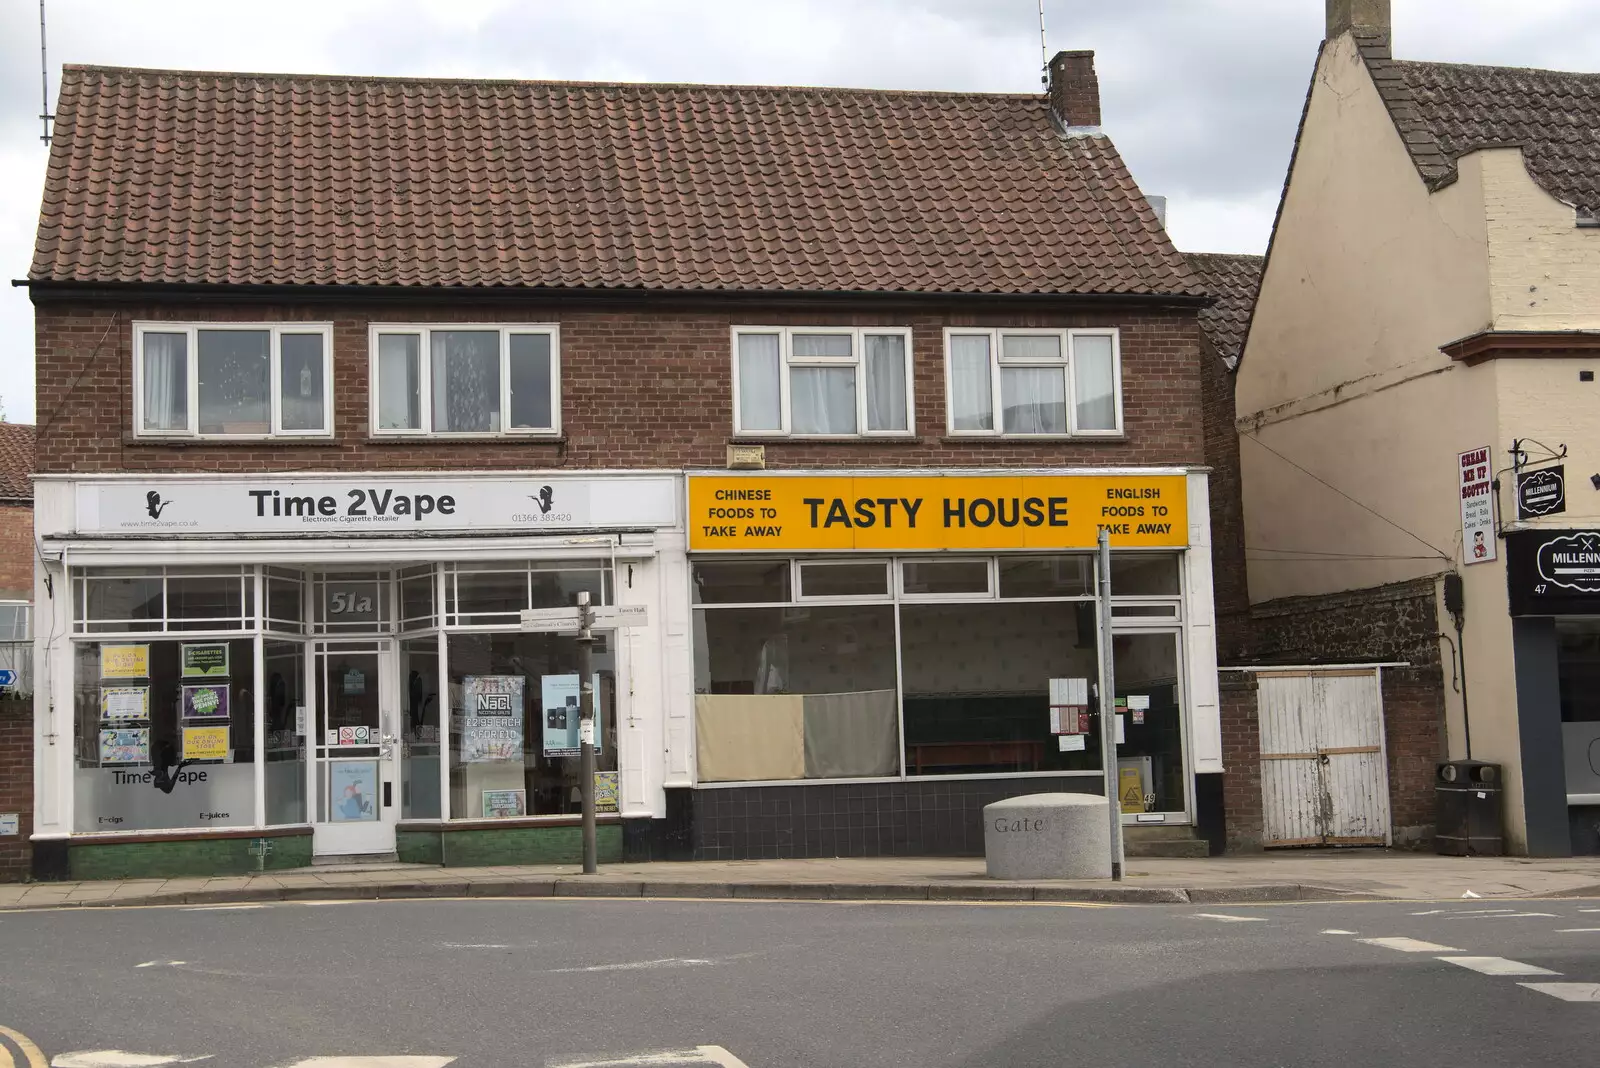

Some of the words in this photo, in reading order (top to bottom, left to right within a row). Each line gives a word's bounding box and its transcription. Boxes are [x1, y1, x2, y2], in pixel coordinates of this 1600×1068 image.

[1461, 449, 1487, 468] CREAM
[1463, 468, 1475, 483] ME
[1476, 465, 1487, 479] UP
[1106, 488, 1161, 500] ENGLISH
[1461, 481, 1490, 499] SCOTTY
[1525, 483, 1557, 496] MILLENNIUM
[714, 490, 772, 501] CHINESE
[249, 490, 337, 516] Time
[347, 488, 456, 521] 2Vape
[708, 508, 755, 518] FOODS
[760, 508, 777, 518] TO
[803, 498, 923, 528] TASTY
[943, 497, 1069, 528] HOUSE
[1101, 506, 1145, 517] FOODS
[1152, 506, 1169, 516] TO
[339, 515, 371, 524] Cigarette
[512, 514, 538, 522] 01366
[539, 513, 572, 522] 383420
[120, 519, 199, 528] www.time2vape.co.uk
[703, 526, 737, 537] TAKE
[744, 526, 782, 537] AWAY
[1097, 524, 1130, 535] TAKE
[1136, 524, 1172, 534] AWAY
[1534, 584, 1547, 594] 47
[331, 591, 373, 614] 51a
[466, 718, 493, 727] £2.99
[495, 718, 522, 727] EACH
[471, 730, 477, 739] 4
[478, 730, 497, 739] FOR
[112, 770, 151, 784] Time
[1144, 793, 1155, 803] 49
[98, 816, 124, 825] E-cigs
[199, 811, 230, 820] E-juices
[994, 817, 1044, 833] Gate
